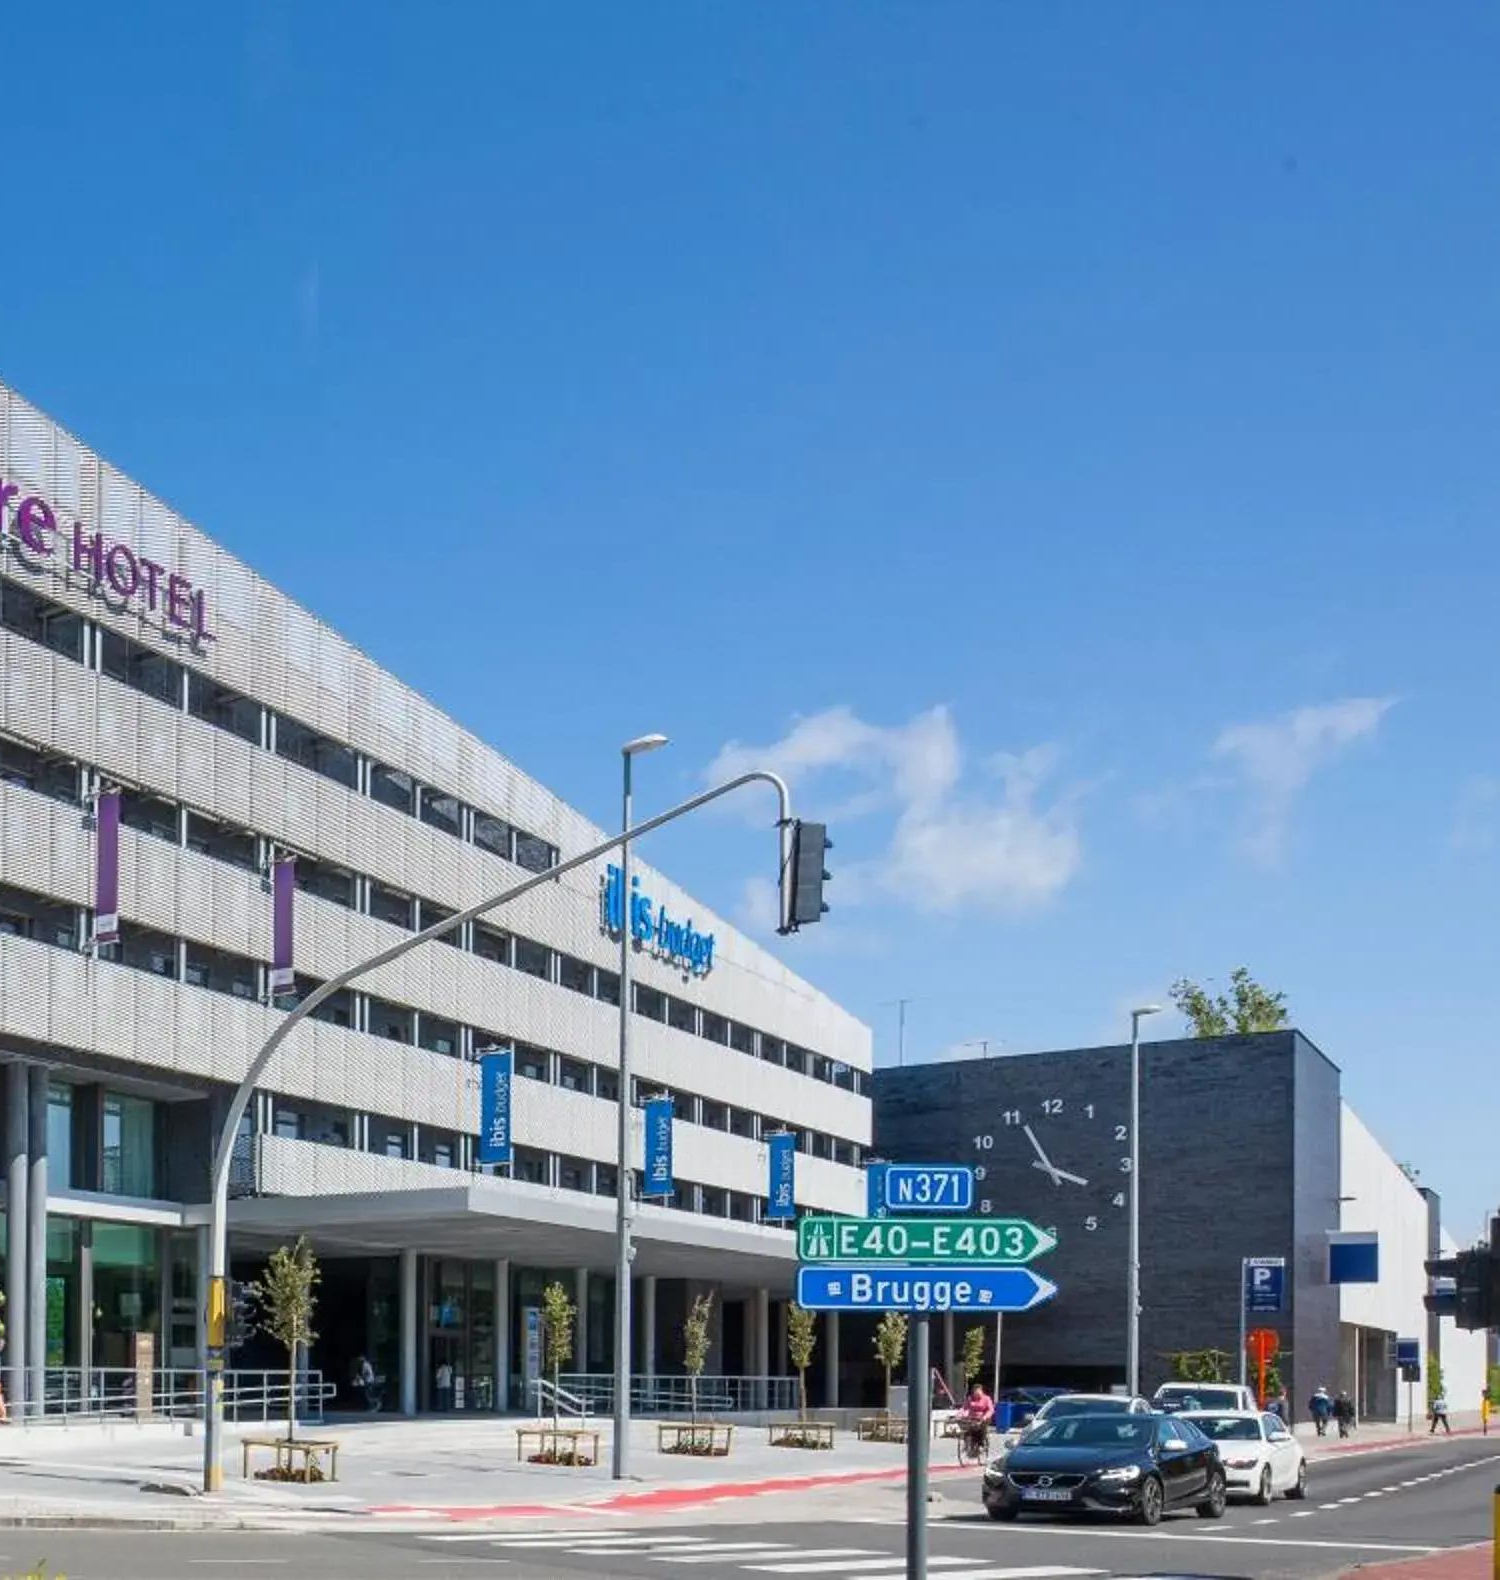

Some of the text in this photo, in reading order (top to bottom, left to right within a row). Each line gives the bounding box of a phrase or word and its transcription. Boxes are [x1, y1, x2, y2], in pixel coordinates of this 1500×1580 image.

[73, 520, 217, 642] HOTEL
[1041, 1099, 1063, 1114] 12
[1084, 1104, 1095, 1119] 1
[1002, 1109, 1021, 1125] 11
[489, 1117, 507, 1148] ibis
[1114, 1125, 1128, 1141] 2
[973, 1135, 994, 1150] 10
[651, 1154, 669, 1182] ibis
[1119, 1157, 1133, 1172] 3
[974, 1166, 987, 1181] 9
[775, 1182, 791, 1207] ibis
[899, 1173, 960, 1203] N371
[980, 1199, 992, 1214] 8
[1112, 1192, 1125, 1208] 4
[1084, 1216, 1098, 1231] 5
[1253, 1268, 1271, 1285] P
[851, 1273, 973, 1310] Brugge
